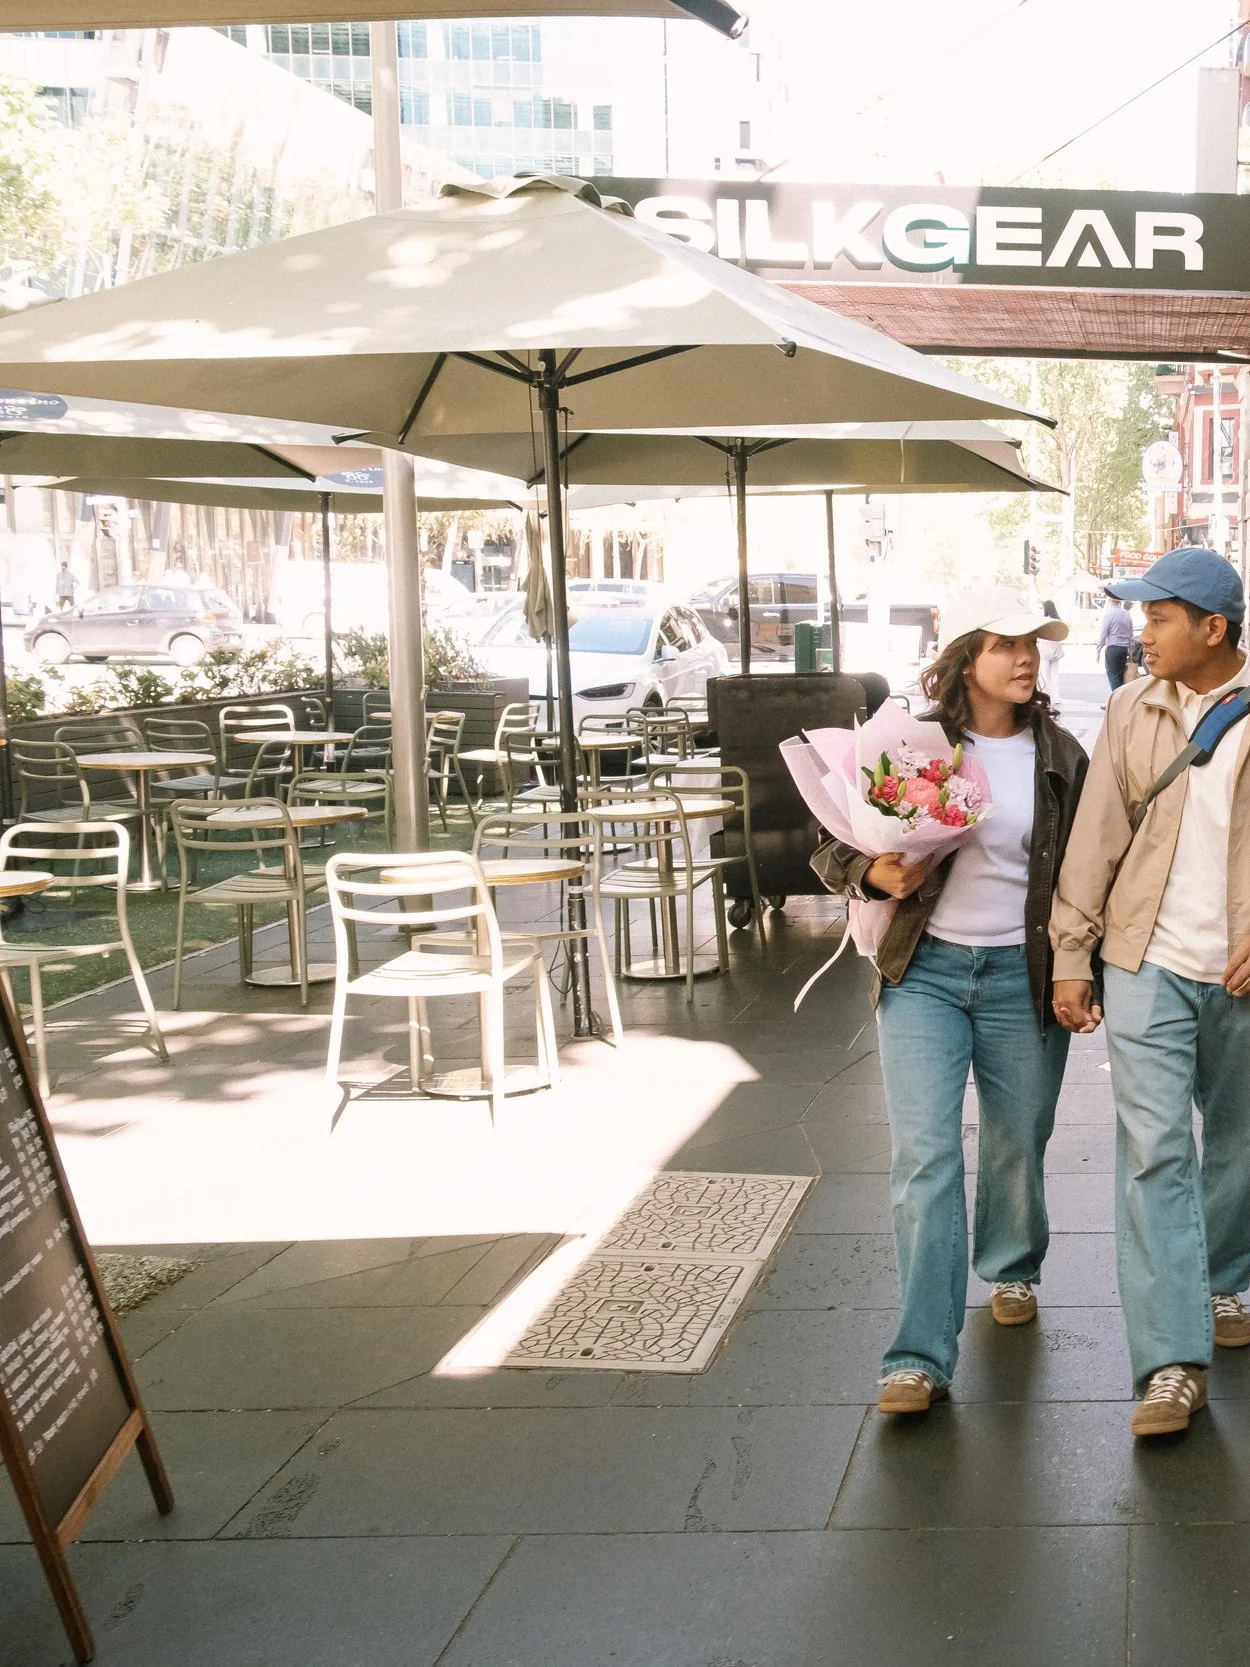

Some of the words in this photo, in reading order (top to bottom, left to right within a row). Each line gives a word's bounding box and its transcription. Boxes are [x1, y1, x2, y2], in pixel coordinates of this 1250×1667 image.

[634, 195, 1204, 272] SILKGEAR
[1119, 551, 1142, 560] FOOD
[1142, 552, 1160, 561] COU
